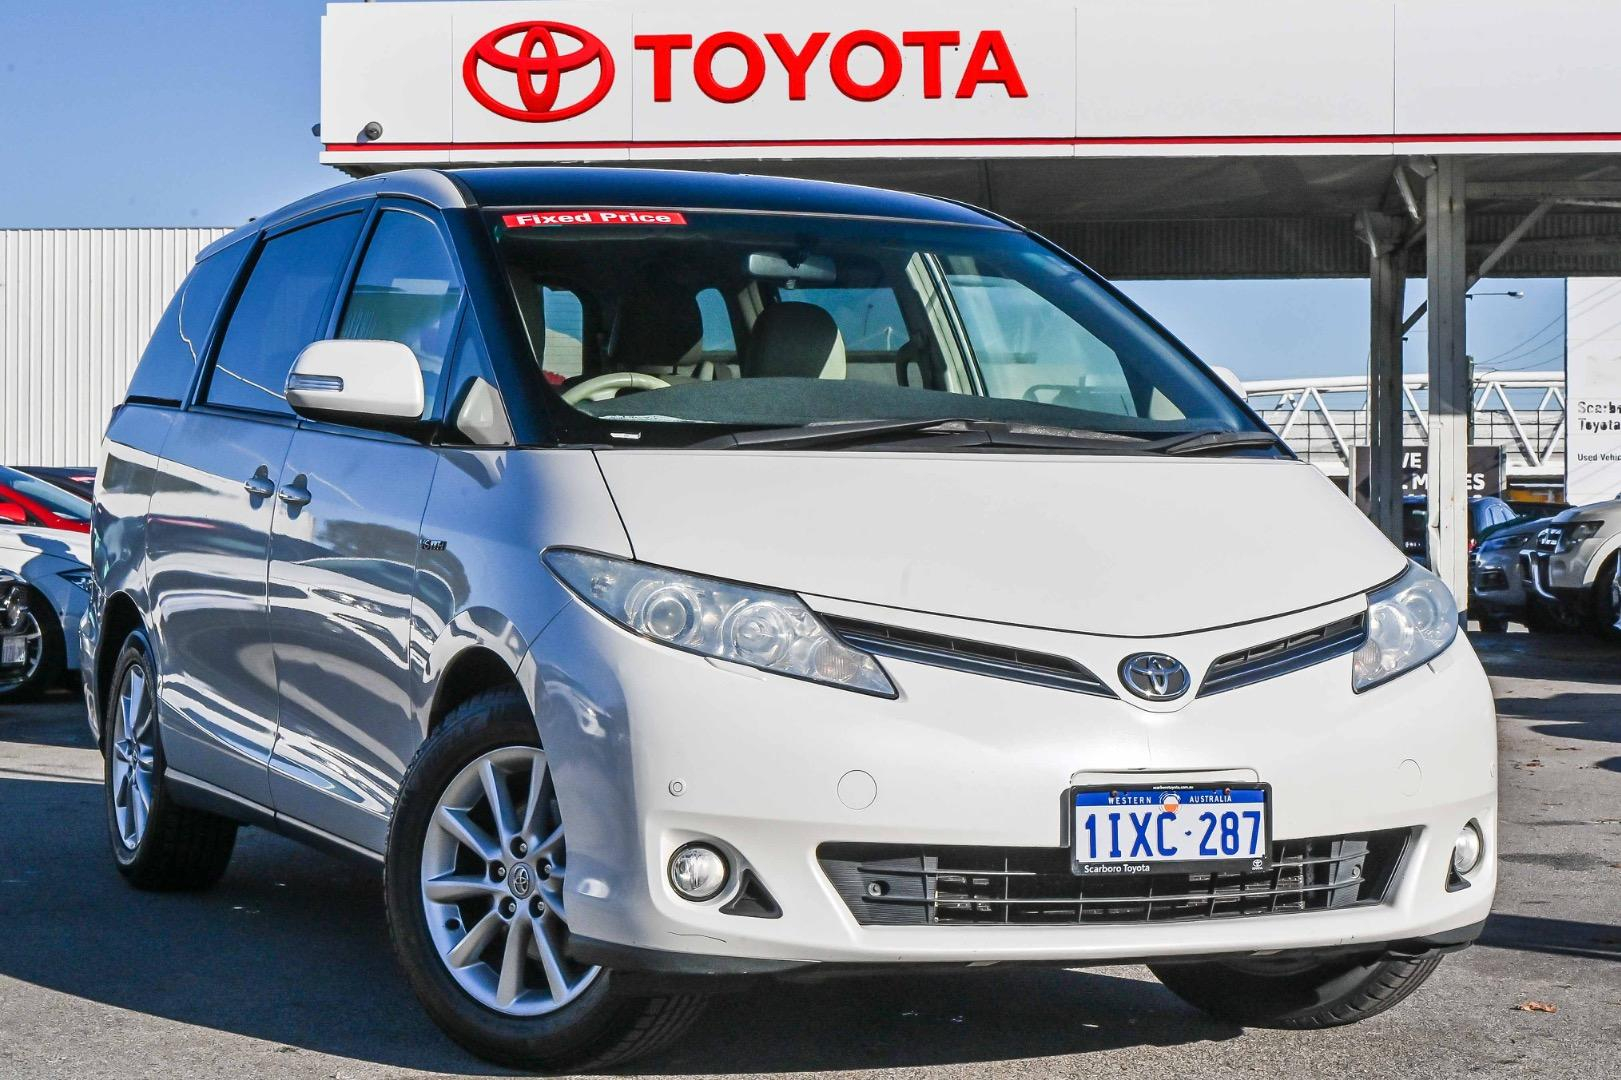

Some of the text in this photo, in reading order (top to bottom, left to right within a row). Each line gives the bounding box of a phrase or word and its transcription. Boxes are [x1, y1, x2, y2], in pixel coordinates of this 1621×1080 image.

[634, 29, 1029, 104] TOYOTA
[516, 212, 672, 225] Fixed Price
[1578, 418, 1621, 433] Toyota
[1577, 453, 1598, 461] Used
[1108, 795, 1232, 805] WESTERN AUSTRALIA
[1084, 864, 1150, 874] Scarboro Toyota
